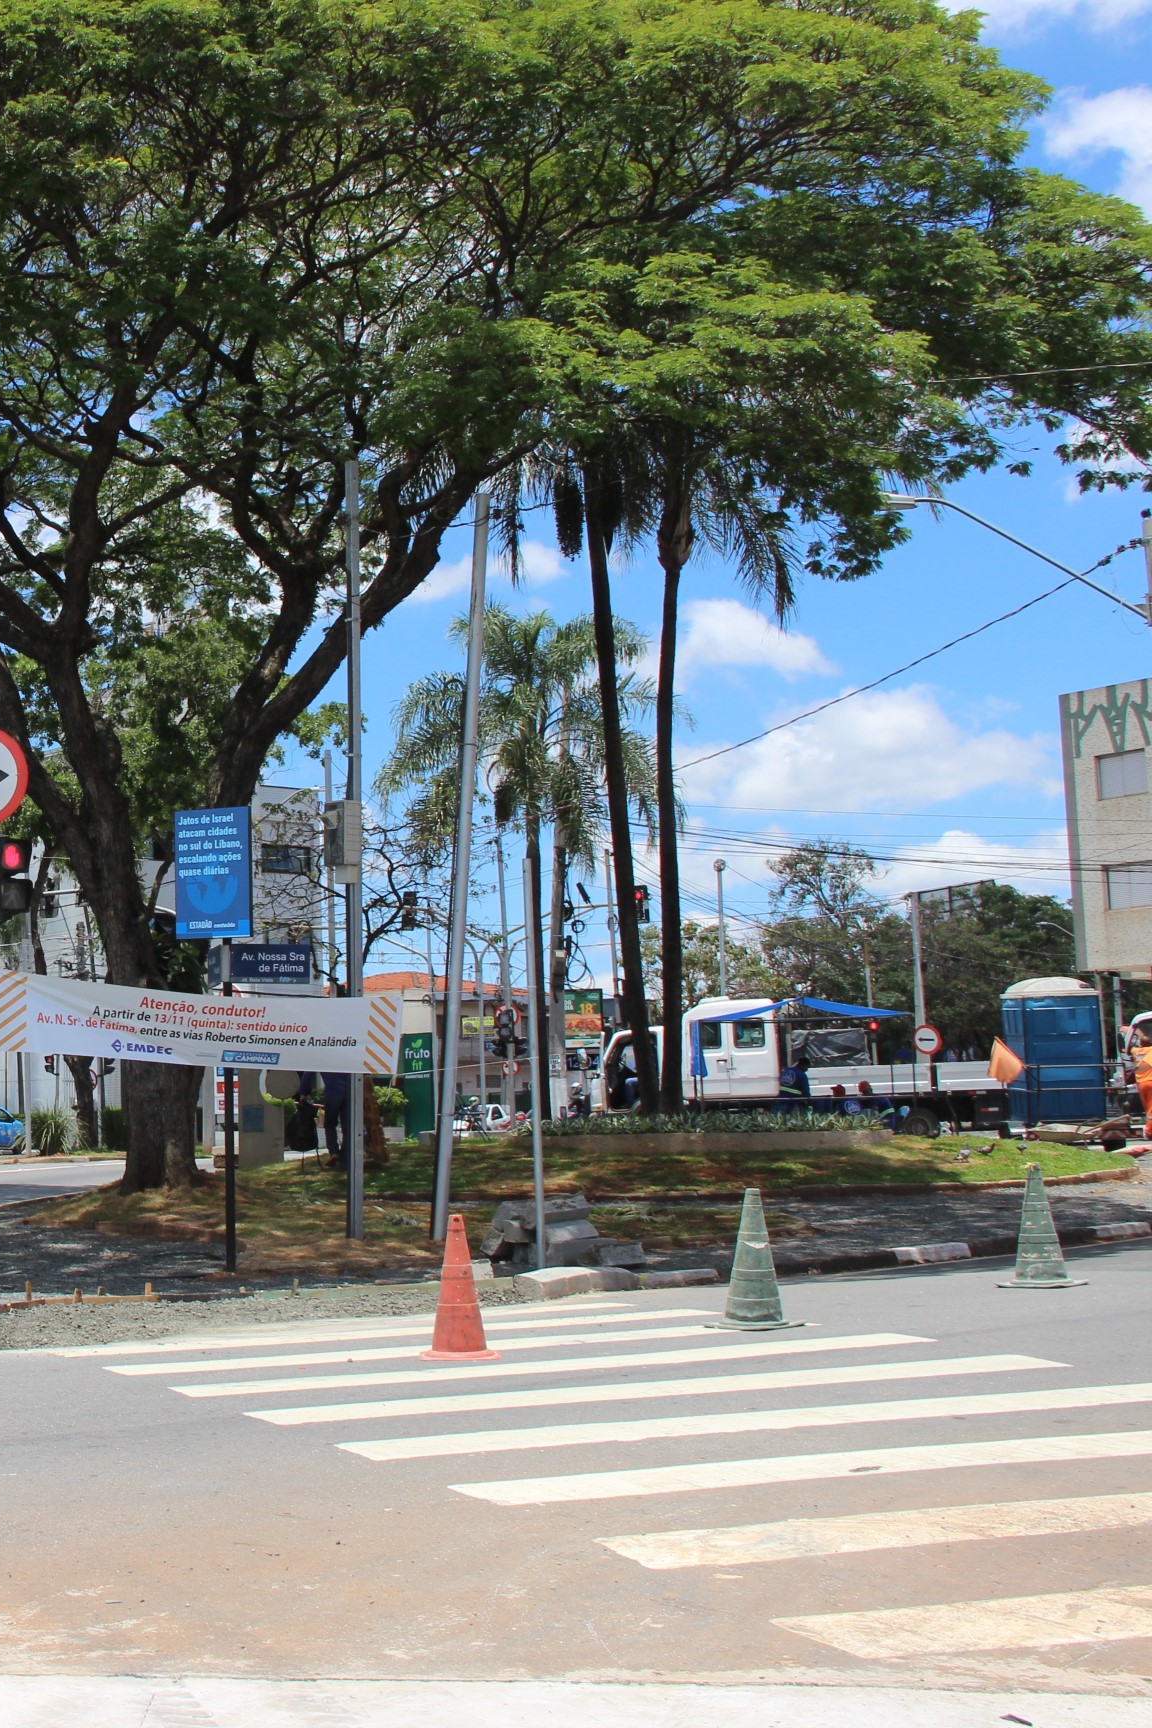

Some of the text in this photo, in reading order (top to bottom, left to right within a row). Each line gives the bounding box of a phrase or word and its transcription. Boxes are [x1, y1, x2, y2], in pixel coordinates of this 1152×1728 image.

[178, 812, 234, 826] Jatos de Israel
[178, 826, 238, 838] atacam cidades
[190, 841, 201, 850] sul
[203, 840, 213, 849] do
[214, 839, 243, 849] Líbano,
[178, 852, 242, 864] escalando ações
[178, 866, 230, 879] quase diárias
[189, 919, 212, 930] ESTADÃO
[241, 952, 306, 961] Av. Nossa Sra
[258, 963, 304, 973] de Fátima
[139, 996, 266, 1018] Atenção, condutor!
[93, 1006, 308, 1033] A partir de 13/11 (quinta): sentido único
[37, 1012, 53, 1024] Av.
[55, 1014, 65, 1025] N.
[85, 1017, 98, 1028] de
[100, 1019, 138, 1034] Fátima,
[140, 1026, 168, 1037] entre
[169, 1030, 181, 1038] as
[183, 1030, 203, 1040] vias
[205, 1031, 247, 1044] Roberto
[248, 1034, 298, 1046] Simonsen
[300, 1038, 305, 1046] e
[307, 1036, 357, 1047] Analândia
[126, 1042, 173, 1055] EMDEC
[405, 1048, 430, 1059] fruto
[234, 1055, 277, 1063] CAMPINAS
[412, 1060, 424, 1071] fit
